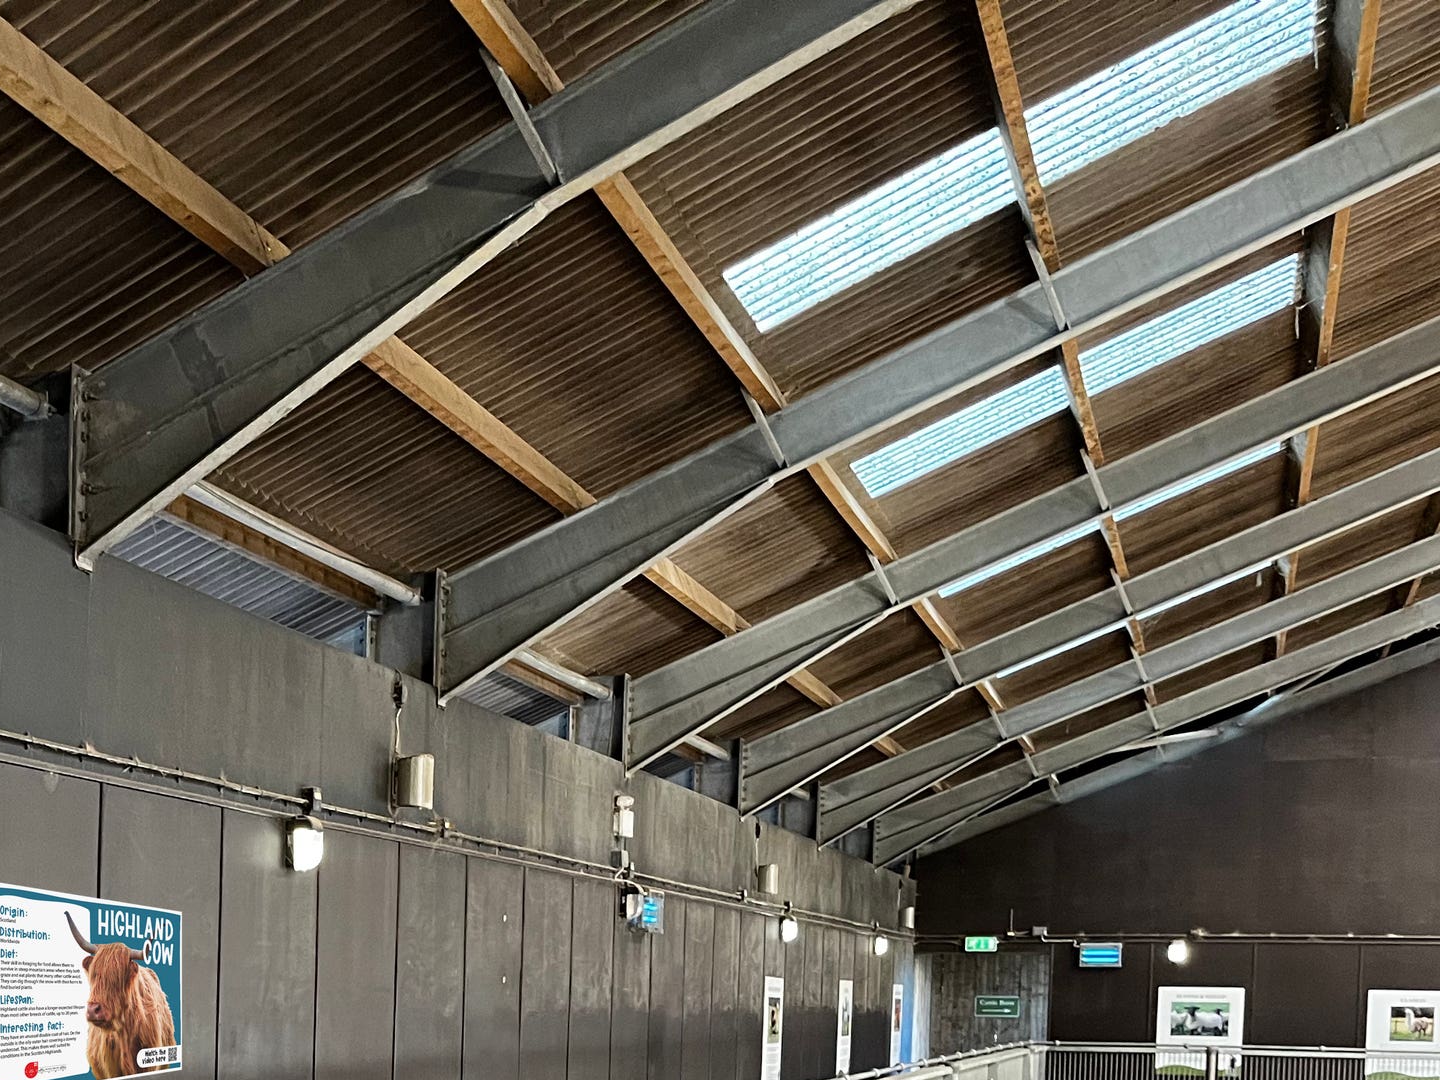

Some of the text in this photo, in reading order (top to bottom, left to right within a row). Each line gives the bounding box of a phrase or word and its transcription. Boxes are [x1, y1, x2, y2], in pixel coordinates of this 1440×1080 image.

[0, 905, 28, 918] Origin:
[98, 909, 173, 941] HIGHLAND
[0, 948, 18, 959] Diet:
[142, 939, 174, 966] COW
[0, 1021, 64, 1034] Interesting fact:
